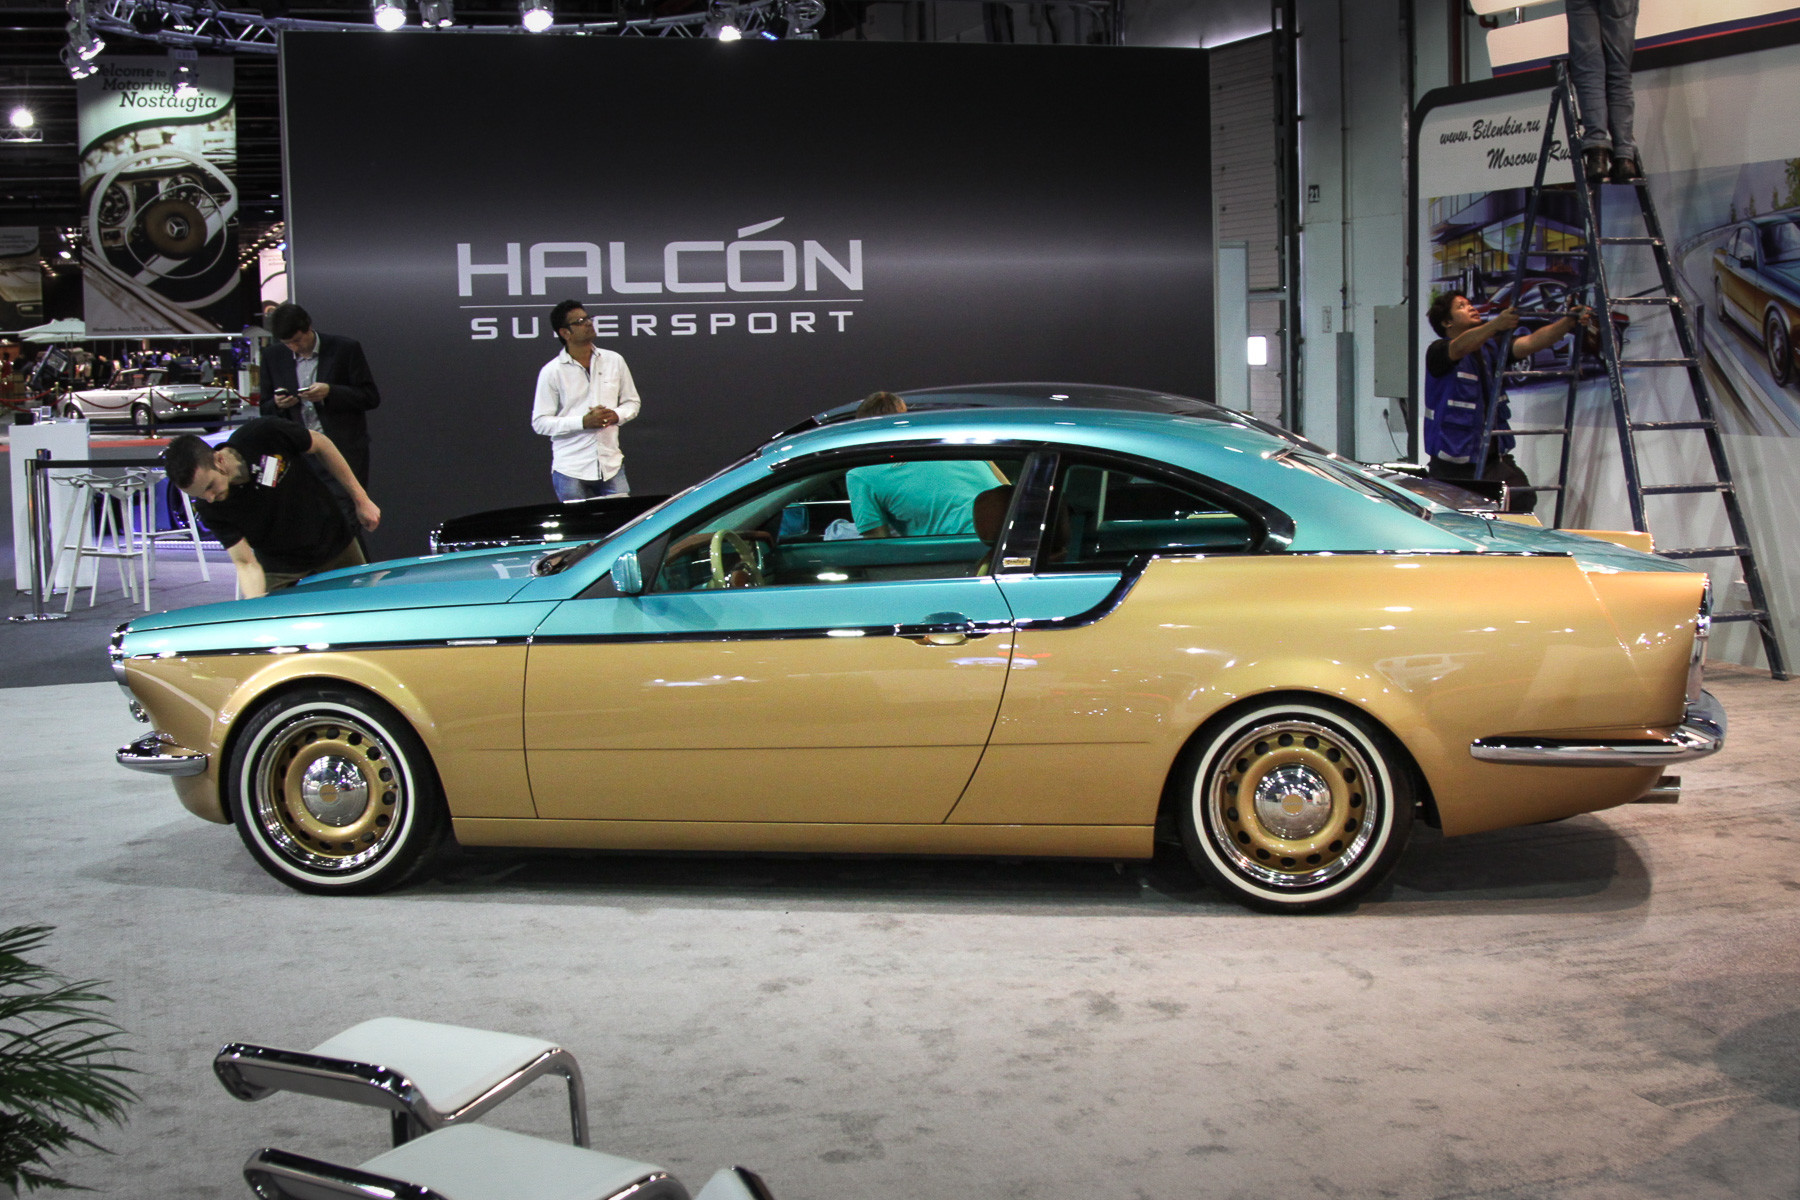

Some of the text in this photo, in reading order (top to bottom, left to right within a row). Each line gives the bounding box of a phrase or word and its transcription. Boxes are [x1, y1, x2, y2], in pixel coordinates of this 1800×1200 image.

[102, 78, 172, 94] Motoring
[156, 69, 167, 77] to
[1439, 115, 1541, 144] www.Bilenkin.ru
[457, 216, 864, 296] HALCÓN
[471, 311, 854, 340] SUERSPORT
